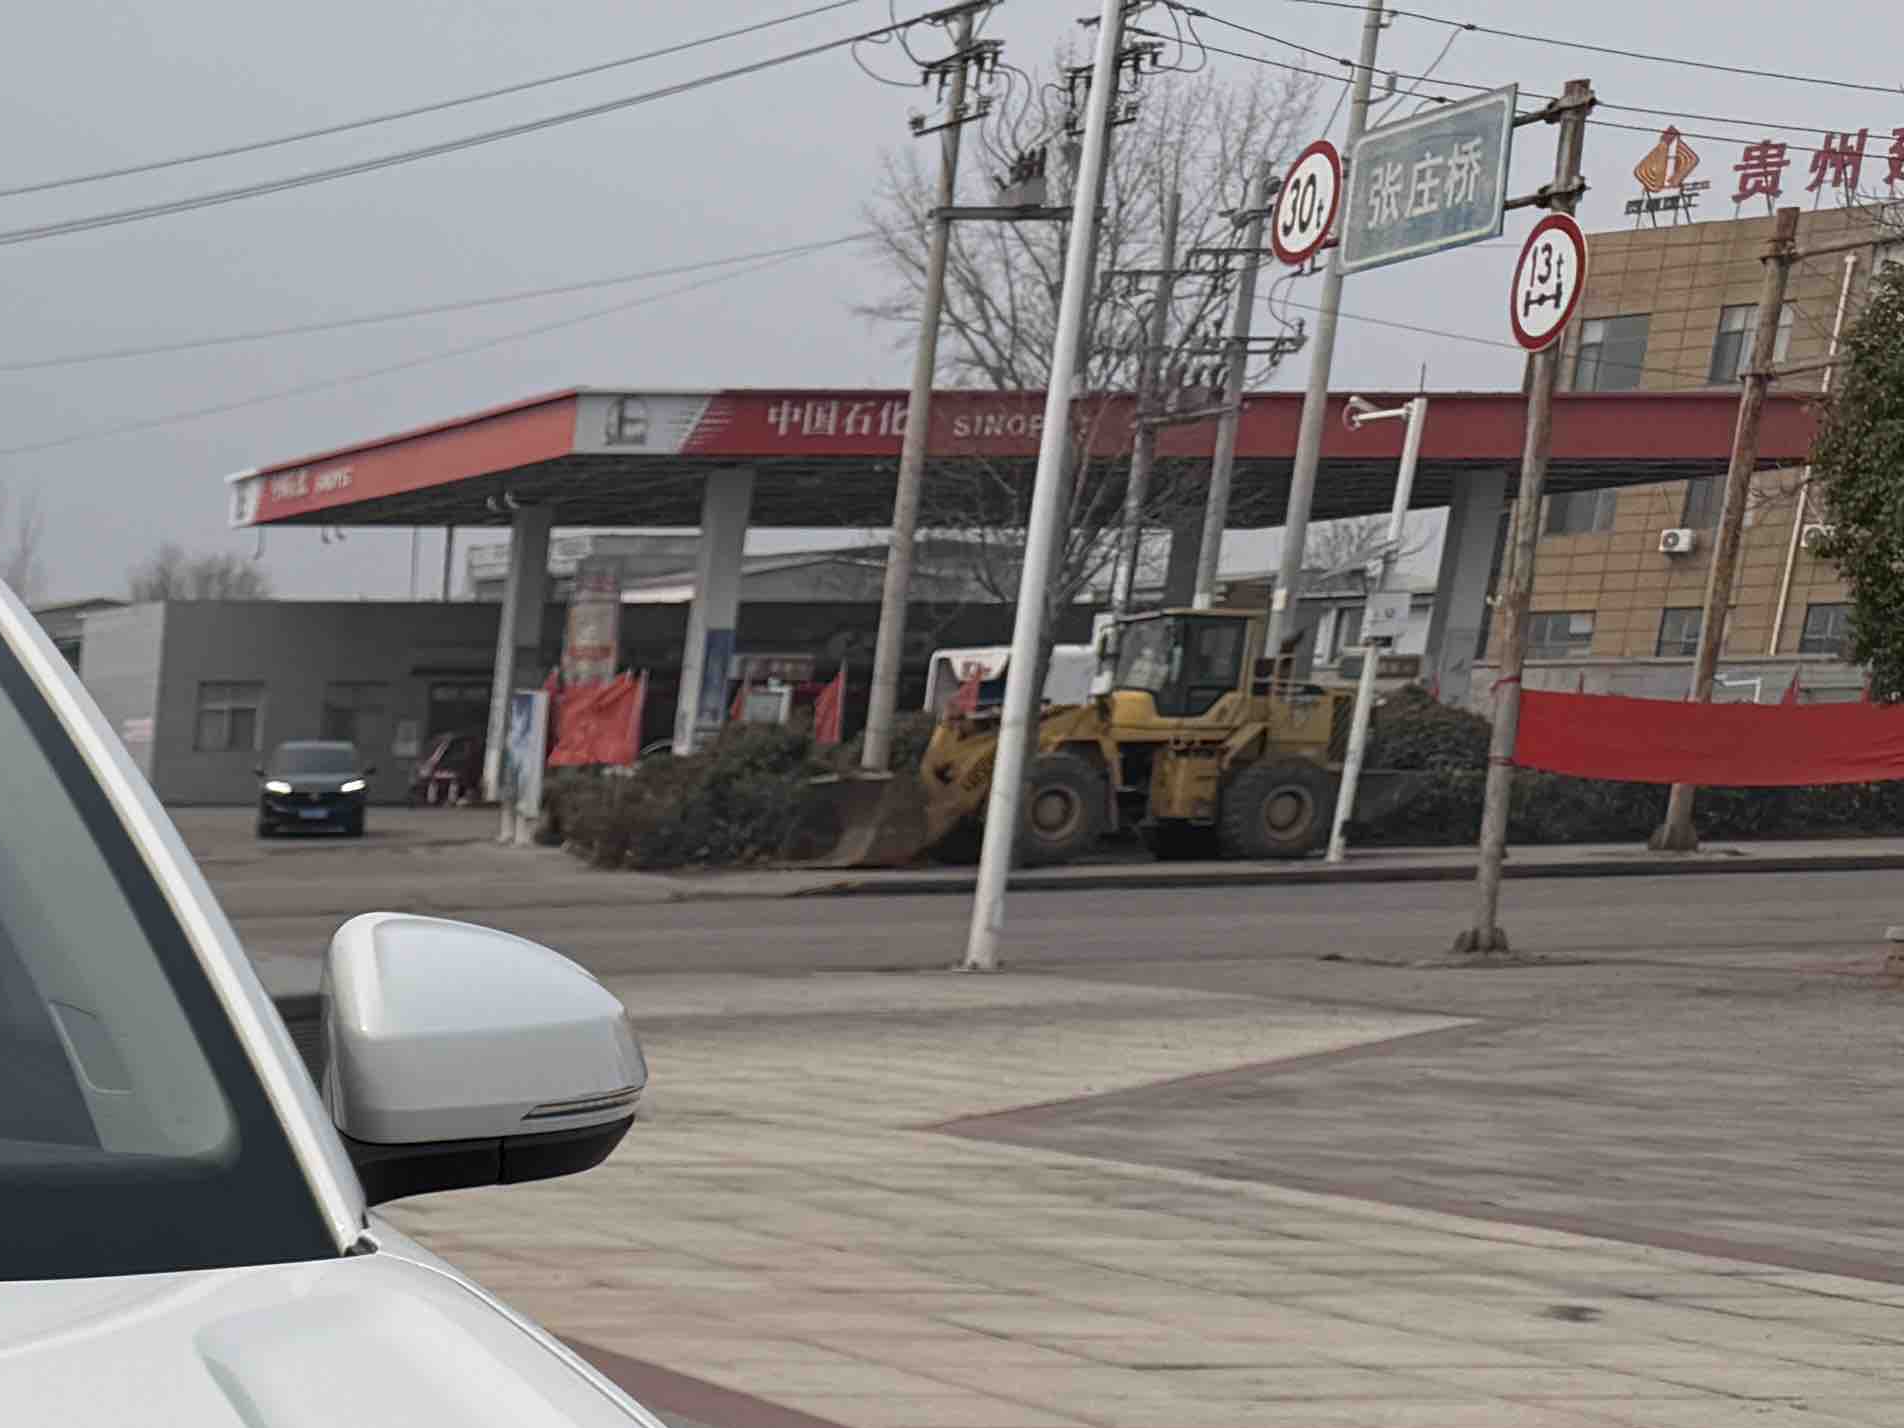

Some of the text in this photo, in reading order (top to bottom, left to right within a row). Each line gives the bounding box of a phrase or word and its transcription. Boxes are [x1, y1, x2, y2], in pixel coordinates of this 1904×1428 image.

[1281, 173, 1325, 237] 30t
[1367, 136, 1484, 228] 张庄桥
[1529, 242, 1566, 288] 13t
[767, 400, 910, 438] 中国石化
[953, 413, 1048, 438] SINOP
